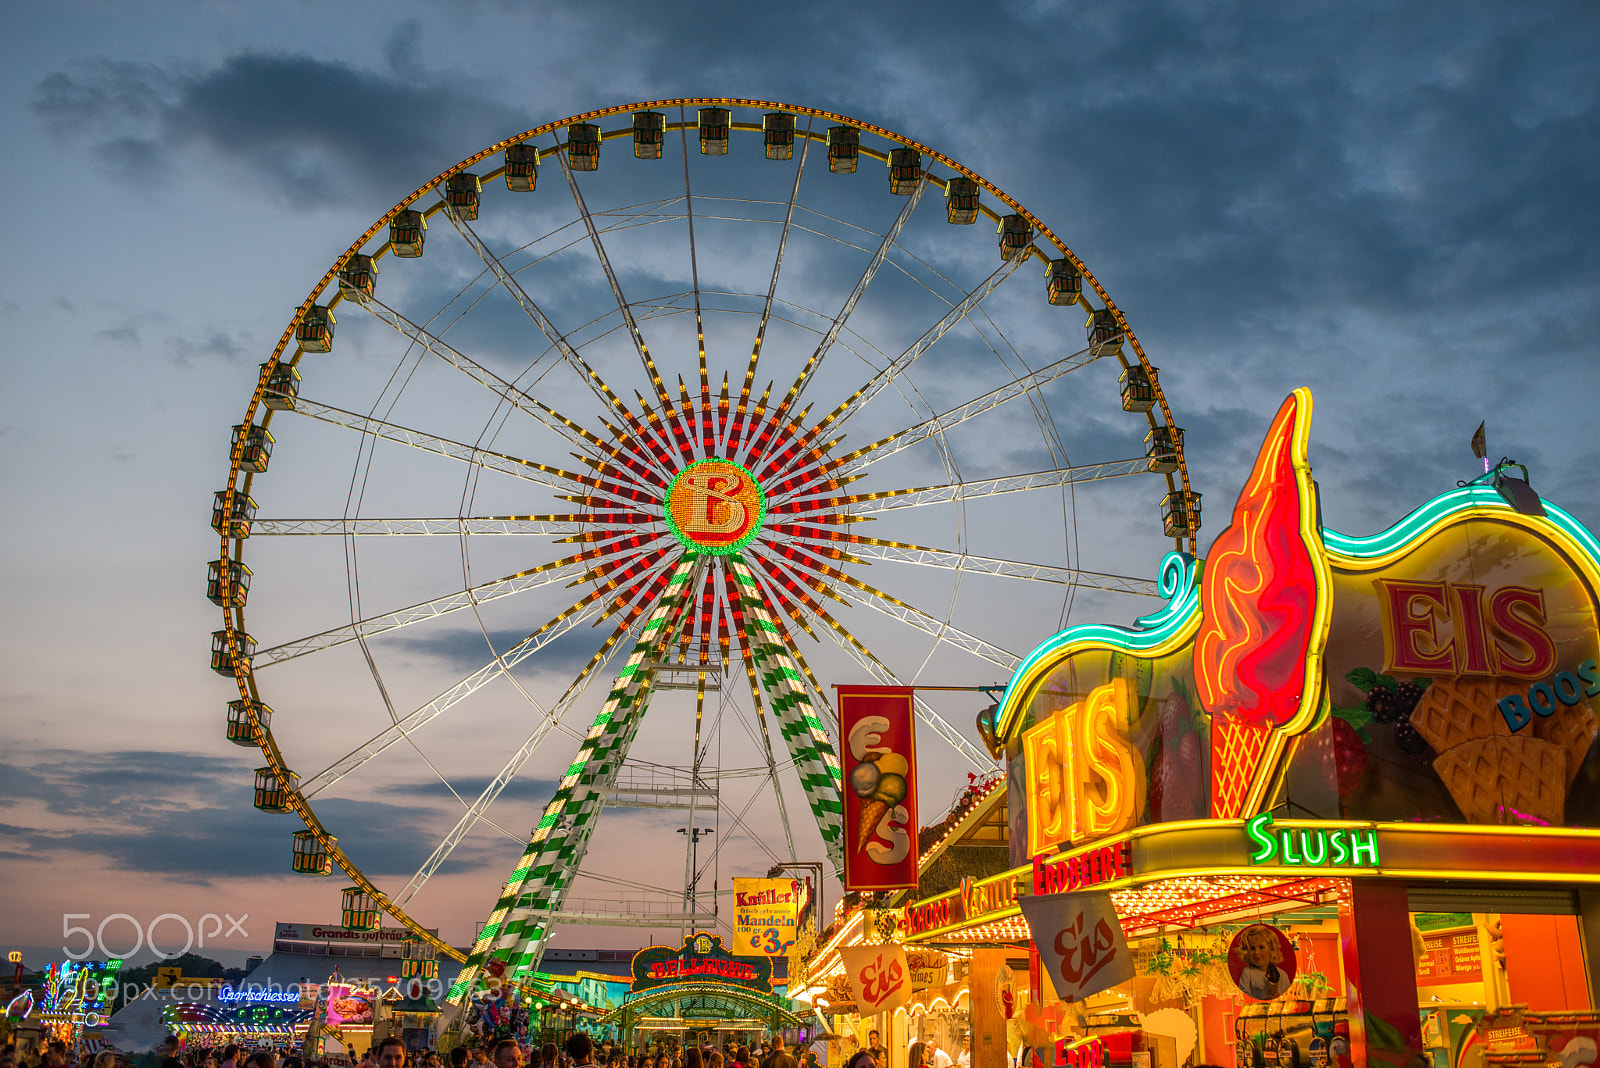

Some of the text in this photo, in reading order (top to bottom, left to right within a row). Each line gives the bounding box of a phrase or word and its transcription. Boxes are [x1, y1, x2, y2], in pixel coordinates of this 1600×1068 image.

[682, 472, 749, 541] B
[1372, 577, 1558, 681] EIS
[1496, 657, 1600, 734] BOOS
[1021, 677, 1147, 860] EIS
[735, 880, 798, 908] Knüller!
[737, 914, 795, 927] Mandeln
[650, 958, 754, 980] BELLEVUE
[696, 937, 711, 954] B
[1054, 911, 1116, 990] Eis
[859, 953, 904, 1008] Eis
